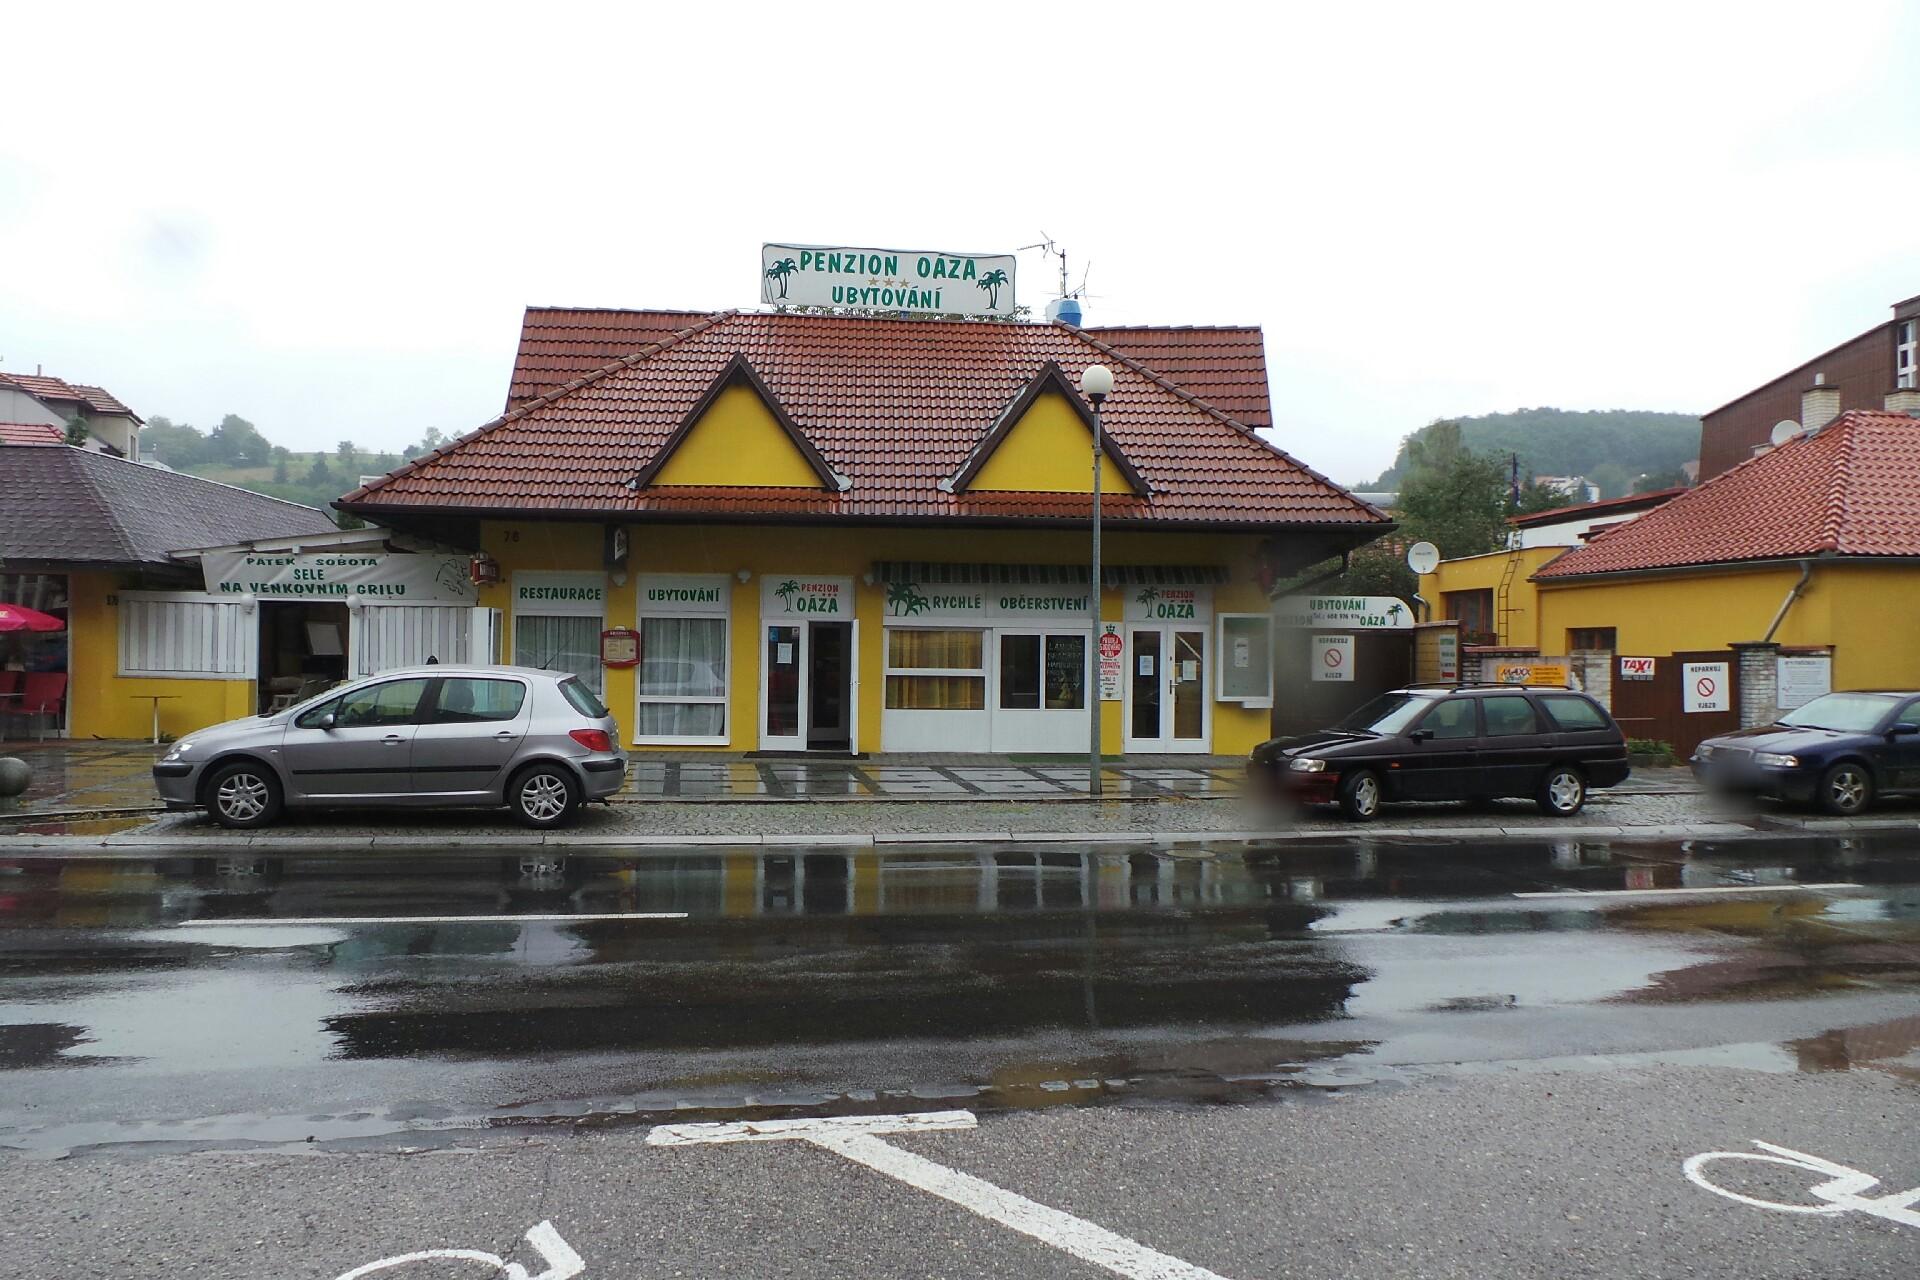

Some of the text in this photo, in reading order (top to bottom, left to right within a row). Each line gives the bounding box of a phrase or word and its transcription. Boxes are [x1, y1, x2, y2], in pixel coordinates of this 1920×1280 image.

[800, 250, 898, 276] PENZION
[831, 286, 943, 309] UBYTOVÁNÍ
[315, 557, 378, 567] SOBOTA
[293, 568, 325, 581] SELE
[219, 582, 244, 593] NA
[356, 584, 406, 595] GRILU
[519, 587, 601, 600] RESTAURACE
[801, 583, 839, 593] PENZION
[648, 588, 721, 602] UBYTOVÁNÍ
[796, 594, 839, 613] OÁZA
[932, 593, 1088, 611] RYCHLÉ OBČERSTVENÍ
[1360, 613, 1386, 626] OÁZA
[1623, 659, 1652, 674] TAXI
